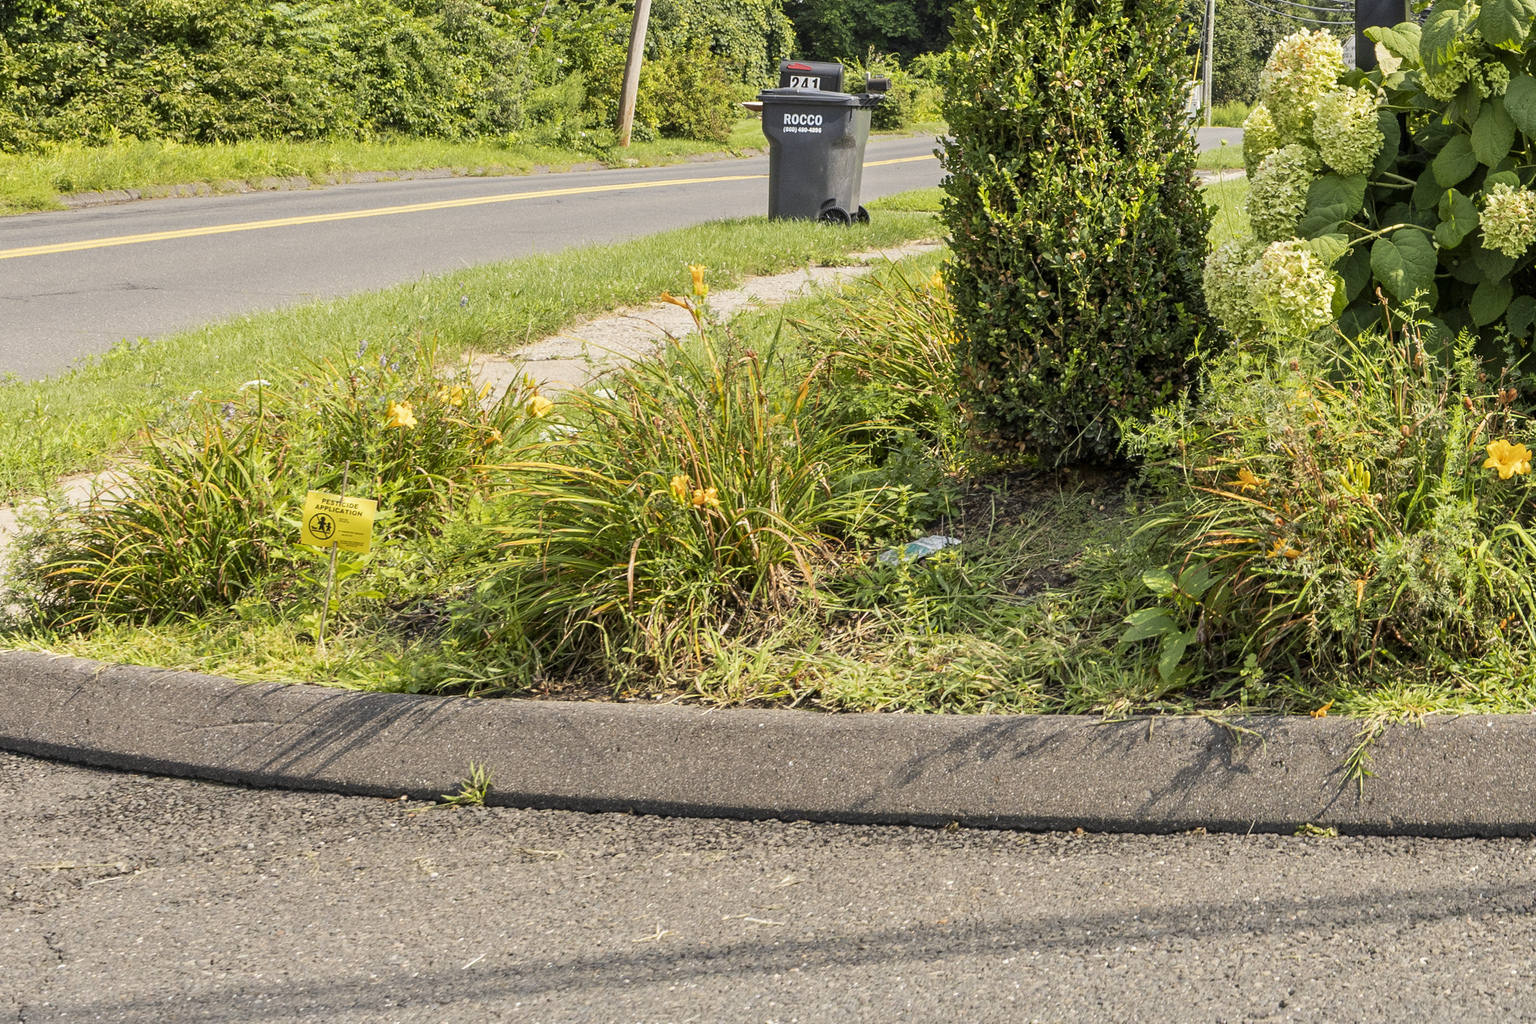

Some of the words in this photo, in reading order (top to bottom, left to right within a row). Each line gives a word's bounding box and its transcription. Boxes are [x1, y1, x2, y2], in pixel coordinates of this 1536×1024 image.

[791, 76, 819, 89] 241
[783, 113, 823, 126] ROCCO
[321, 497, 360, 510] PESTICIDE
[315, 504, 363, 517] APPLICATION
